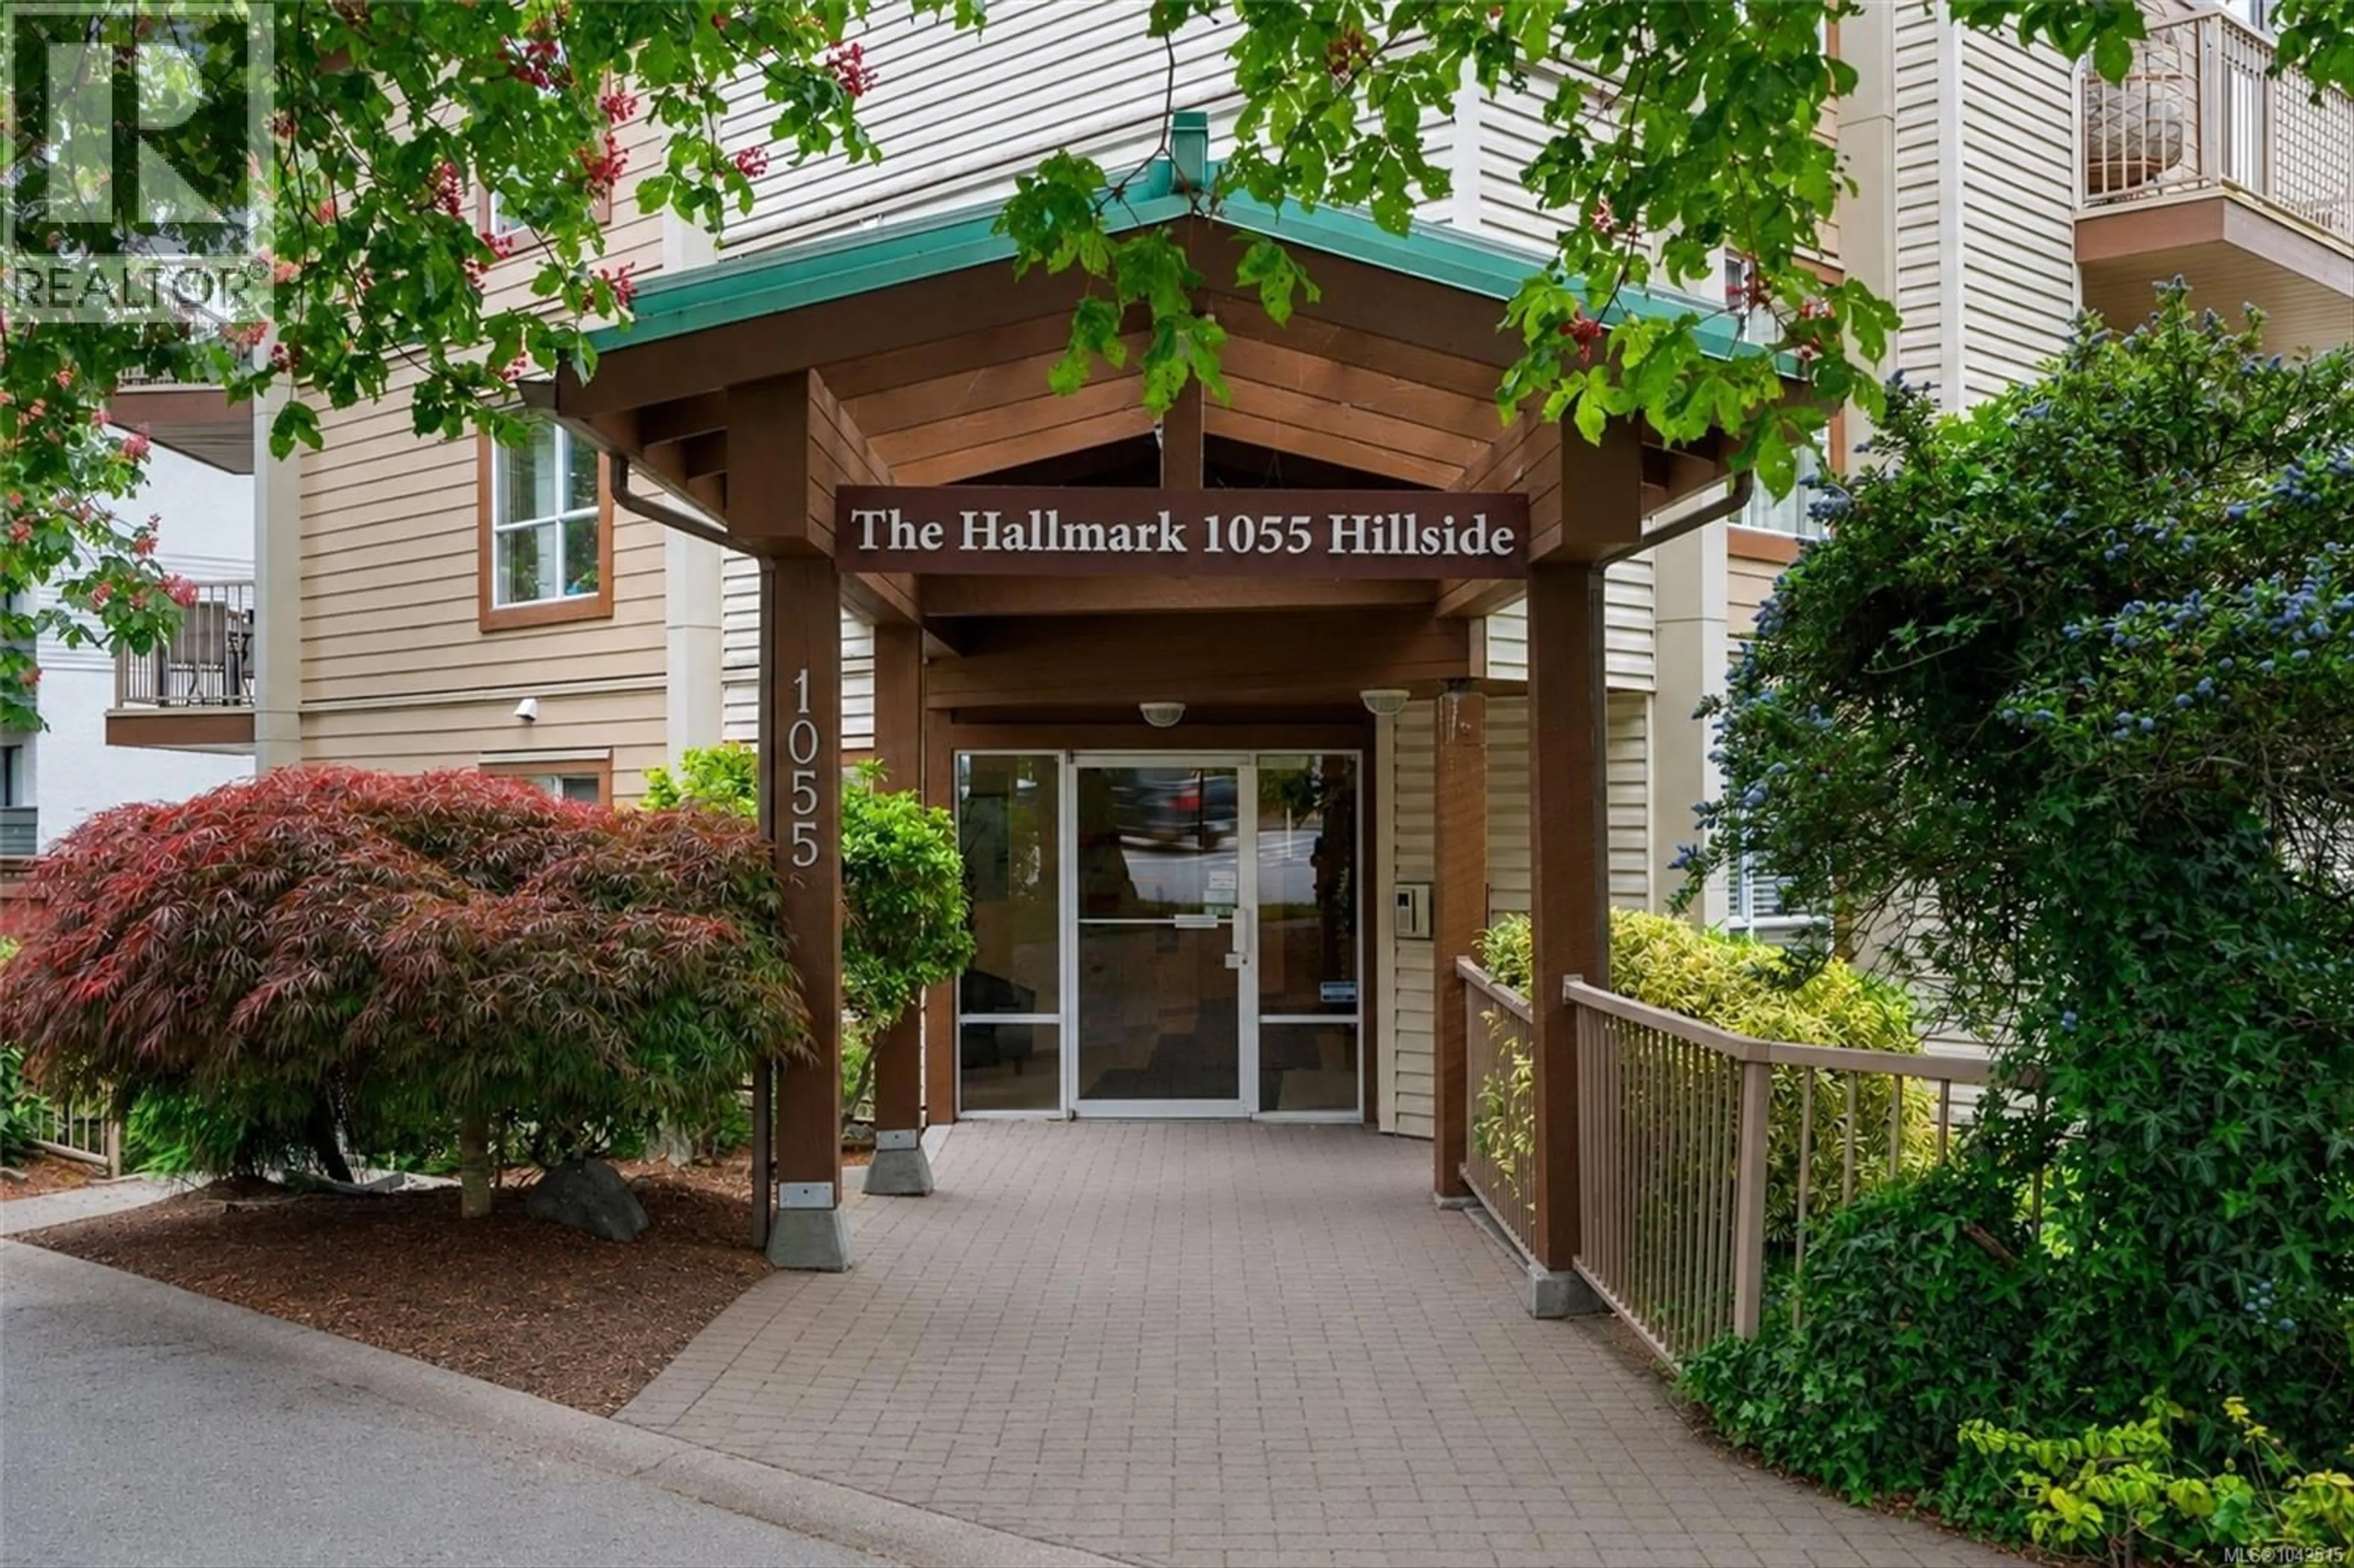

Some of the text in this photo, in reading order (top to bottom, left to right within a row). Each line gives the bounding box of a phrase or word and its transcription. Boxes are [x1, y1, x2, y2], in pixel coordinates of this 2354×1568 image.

[851, 508, 1515, 555] The Hallmark 1055 Hillside
[788, 668, 819, 867] 1055
